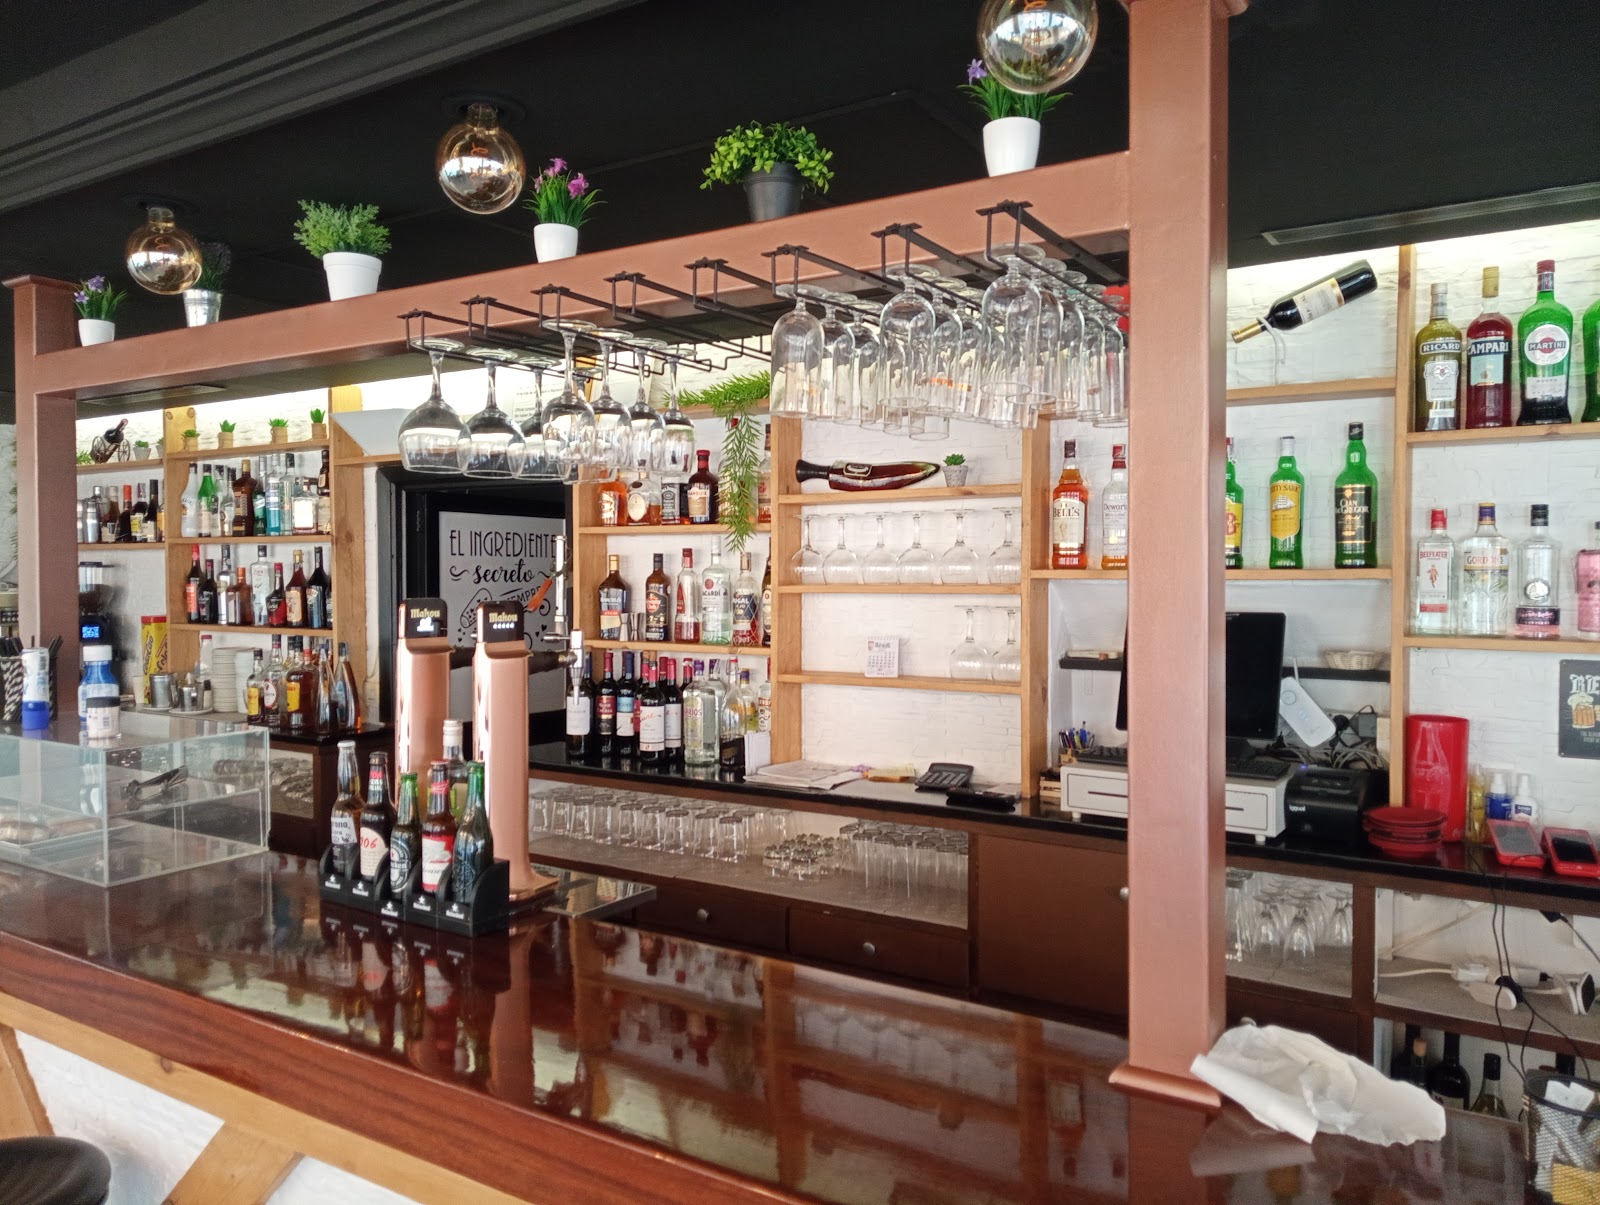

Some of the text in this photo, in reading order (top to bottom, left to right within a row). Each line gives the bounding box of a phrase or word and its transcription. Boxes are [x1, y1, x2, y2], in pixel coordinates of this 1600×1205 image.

[1423, 342, 1460, 352] RICARD
[1528, 340, 1566, 351] MARTINI
[449, 530, 556, 558] EL INGREDIENTE
[472, 559, 535, 584] secreto
[410, 608, 441, 619] Mahou
[489, 612, 518, 623] Mahou
[360, 836, 378, 849] 06
